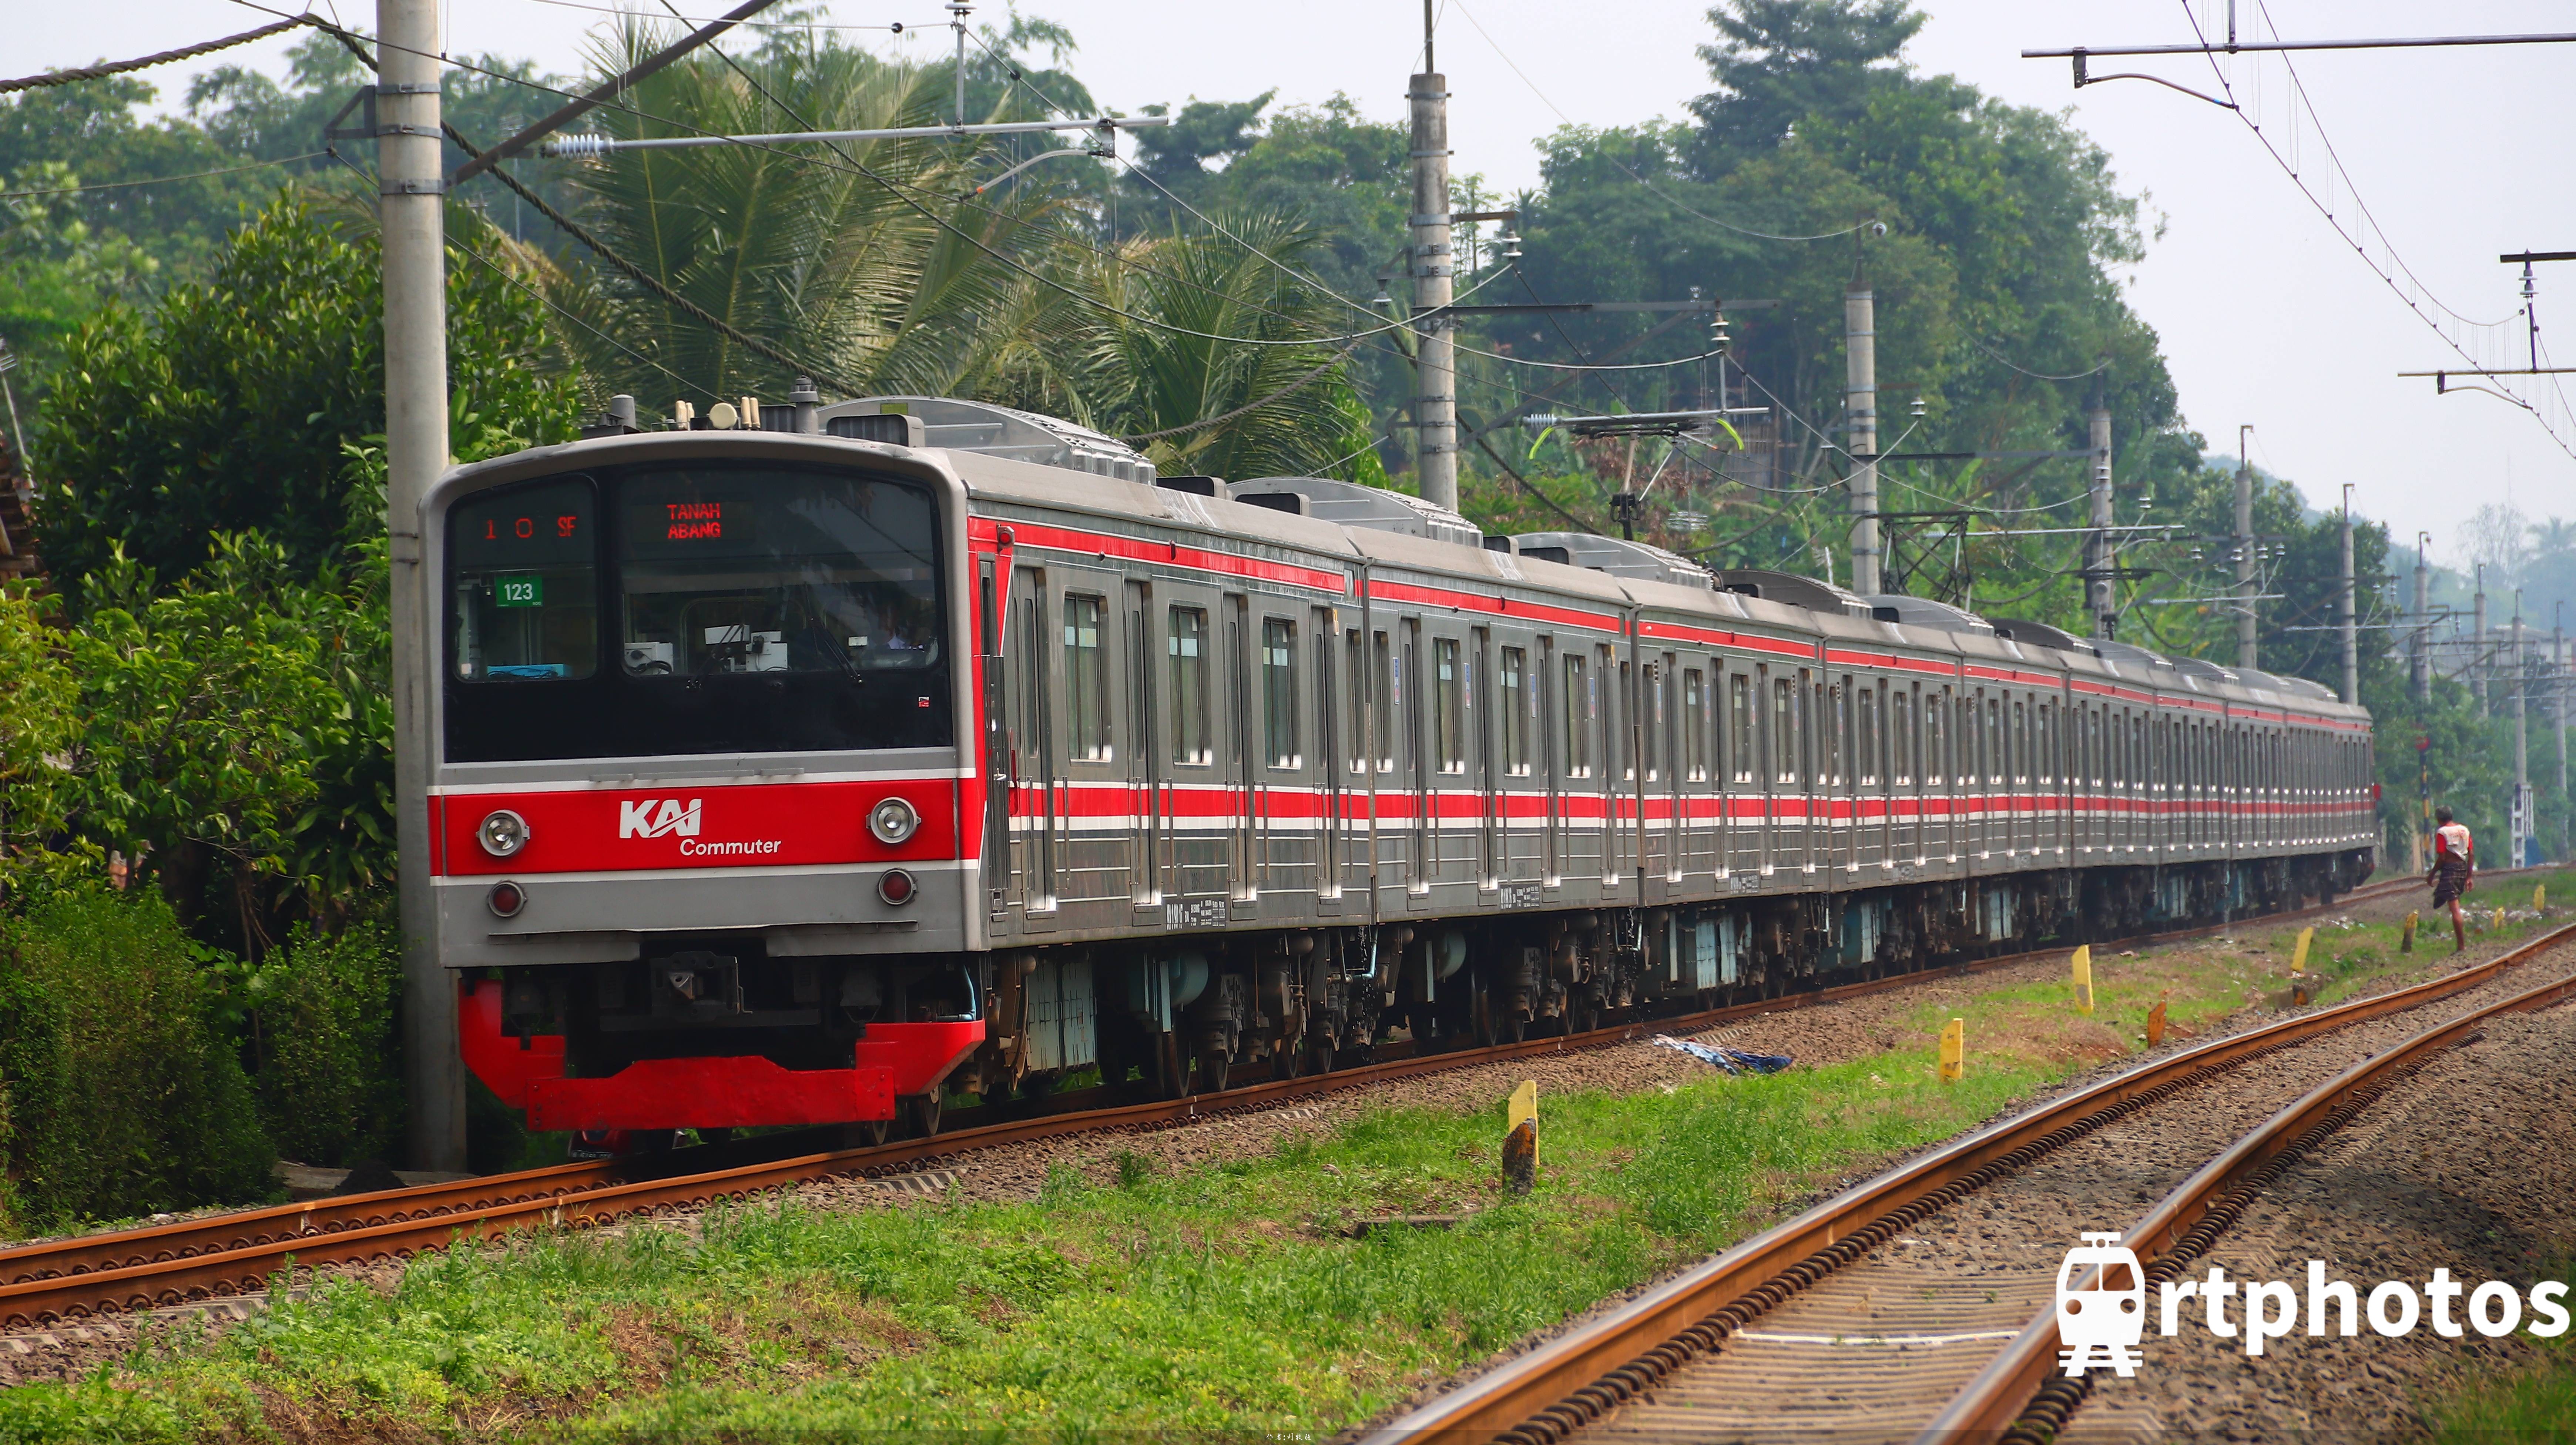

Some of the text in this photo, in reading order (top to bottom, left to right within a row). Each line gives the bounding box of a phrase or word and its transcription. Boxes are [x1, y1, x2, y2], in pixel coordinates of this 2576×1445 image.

[667, 503, 721, 520] TANAH
[557, 516, 577, 537] SF
[667, 522, 721, 539] ABANG
[504, 583, 533, 600] 123
[620, 798, 702, 839] KAI
[680, 838, 781, 856] Commuter
